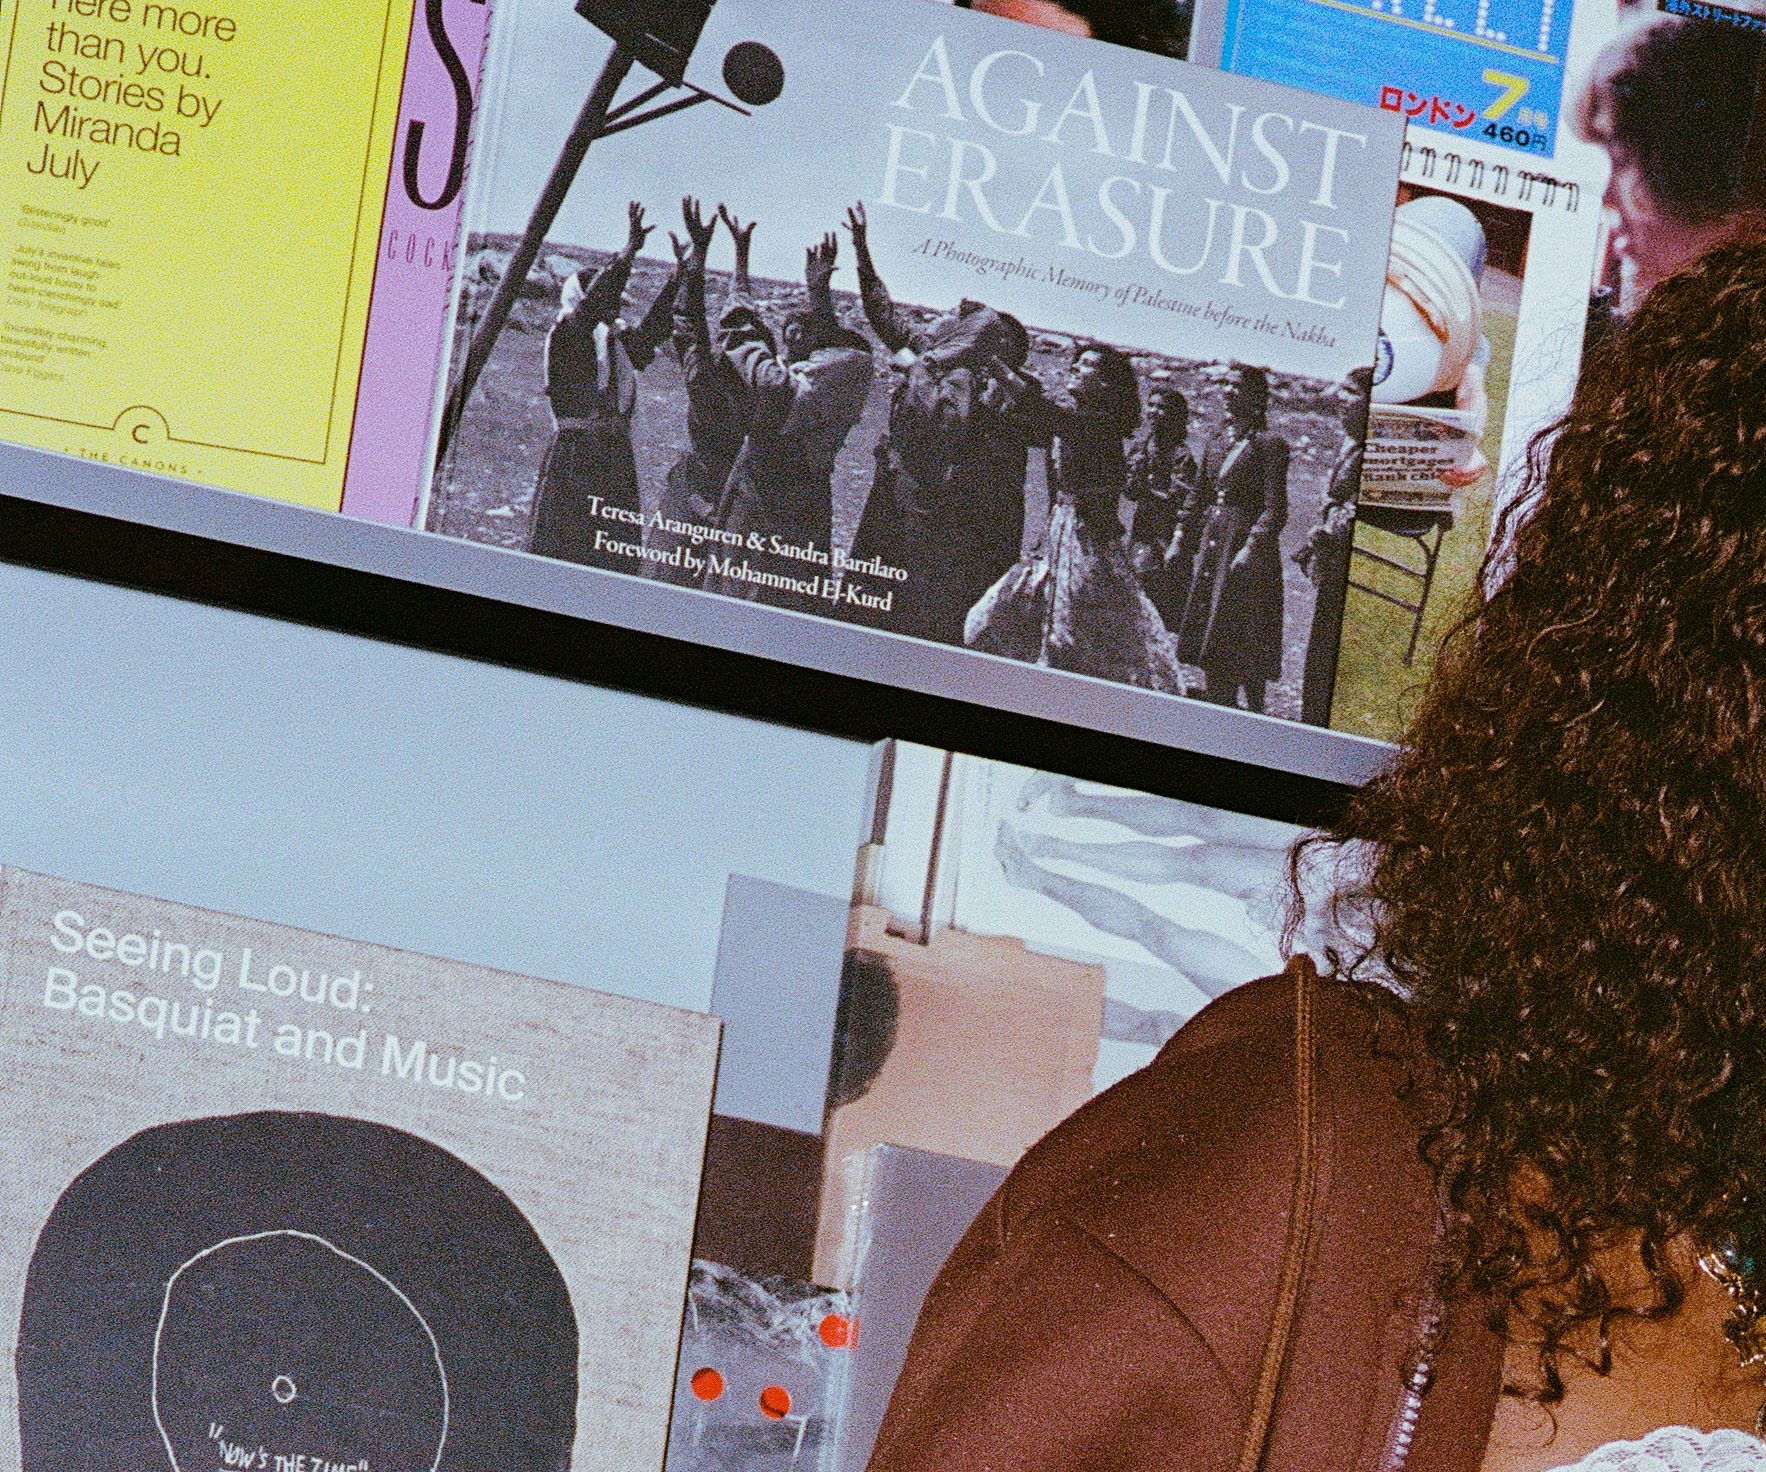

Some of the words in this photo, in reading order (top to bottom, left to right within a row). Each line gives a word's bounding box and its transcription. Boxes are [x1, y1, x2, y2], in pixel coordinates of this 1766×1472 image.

[46, 22, 125, 64] than
[136, 42, 211, 79] you.
[142, 3, 238, 42] more
[33, 100, 181, 157] Miranda
[39, 60, 166, 113] Stories
[177, 84, 223, 129] by
[888, 34, 1371, 211] AGAINST
[1379, 85, 1477, 129] ロンドン
[26, 143, 100, 191] July
[879, 123, 1353, 311] ERASURE
[912, 238, 933, 256] A
[933, 240, 1039, 281] Photographic
[1039, 265, 1113, 302] Memory
[1113, 281, 1135, 310] of
[1133, 285, 1204, 319] Palestine
[1203, 302, 1253, 332] before
[1253, 312, 1280, 337] the
[1280, 319, 1339, 349] Nakba
[587, 494, 645, 527] Teresa
[648, 510, 744, 548] Aranguren
[745, 532, 767, 552] &
[769, 534, 829, 567] Sandra
[831, 548, 909, 583] Barrilaro
[593, 529, 681, 571] Foreword
[683, 547, 707, 577] by
[705, 554, 819, 596] Mohammed
[821, 577, 894, 612] El-Kurd
[50, 909, 223, 992] Seeing
[238, 947, 375, 1013] Loud:
[43, 965, 262, 1049] Basquiat
[273, 1019, 368, 1070] and
[379, 1033, 528, 1102] Music
